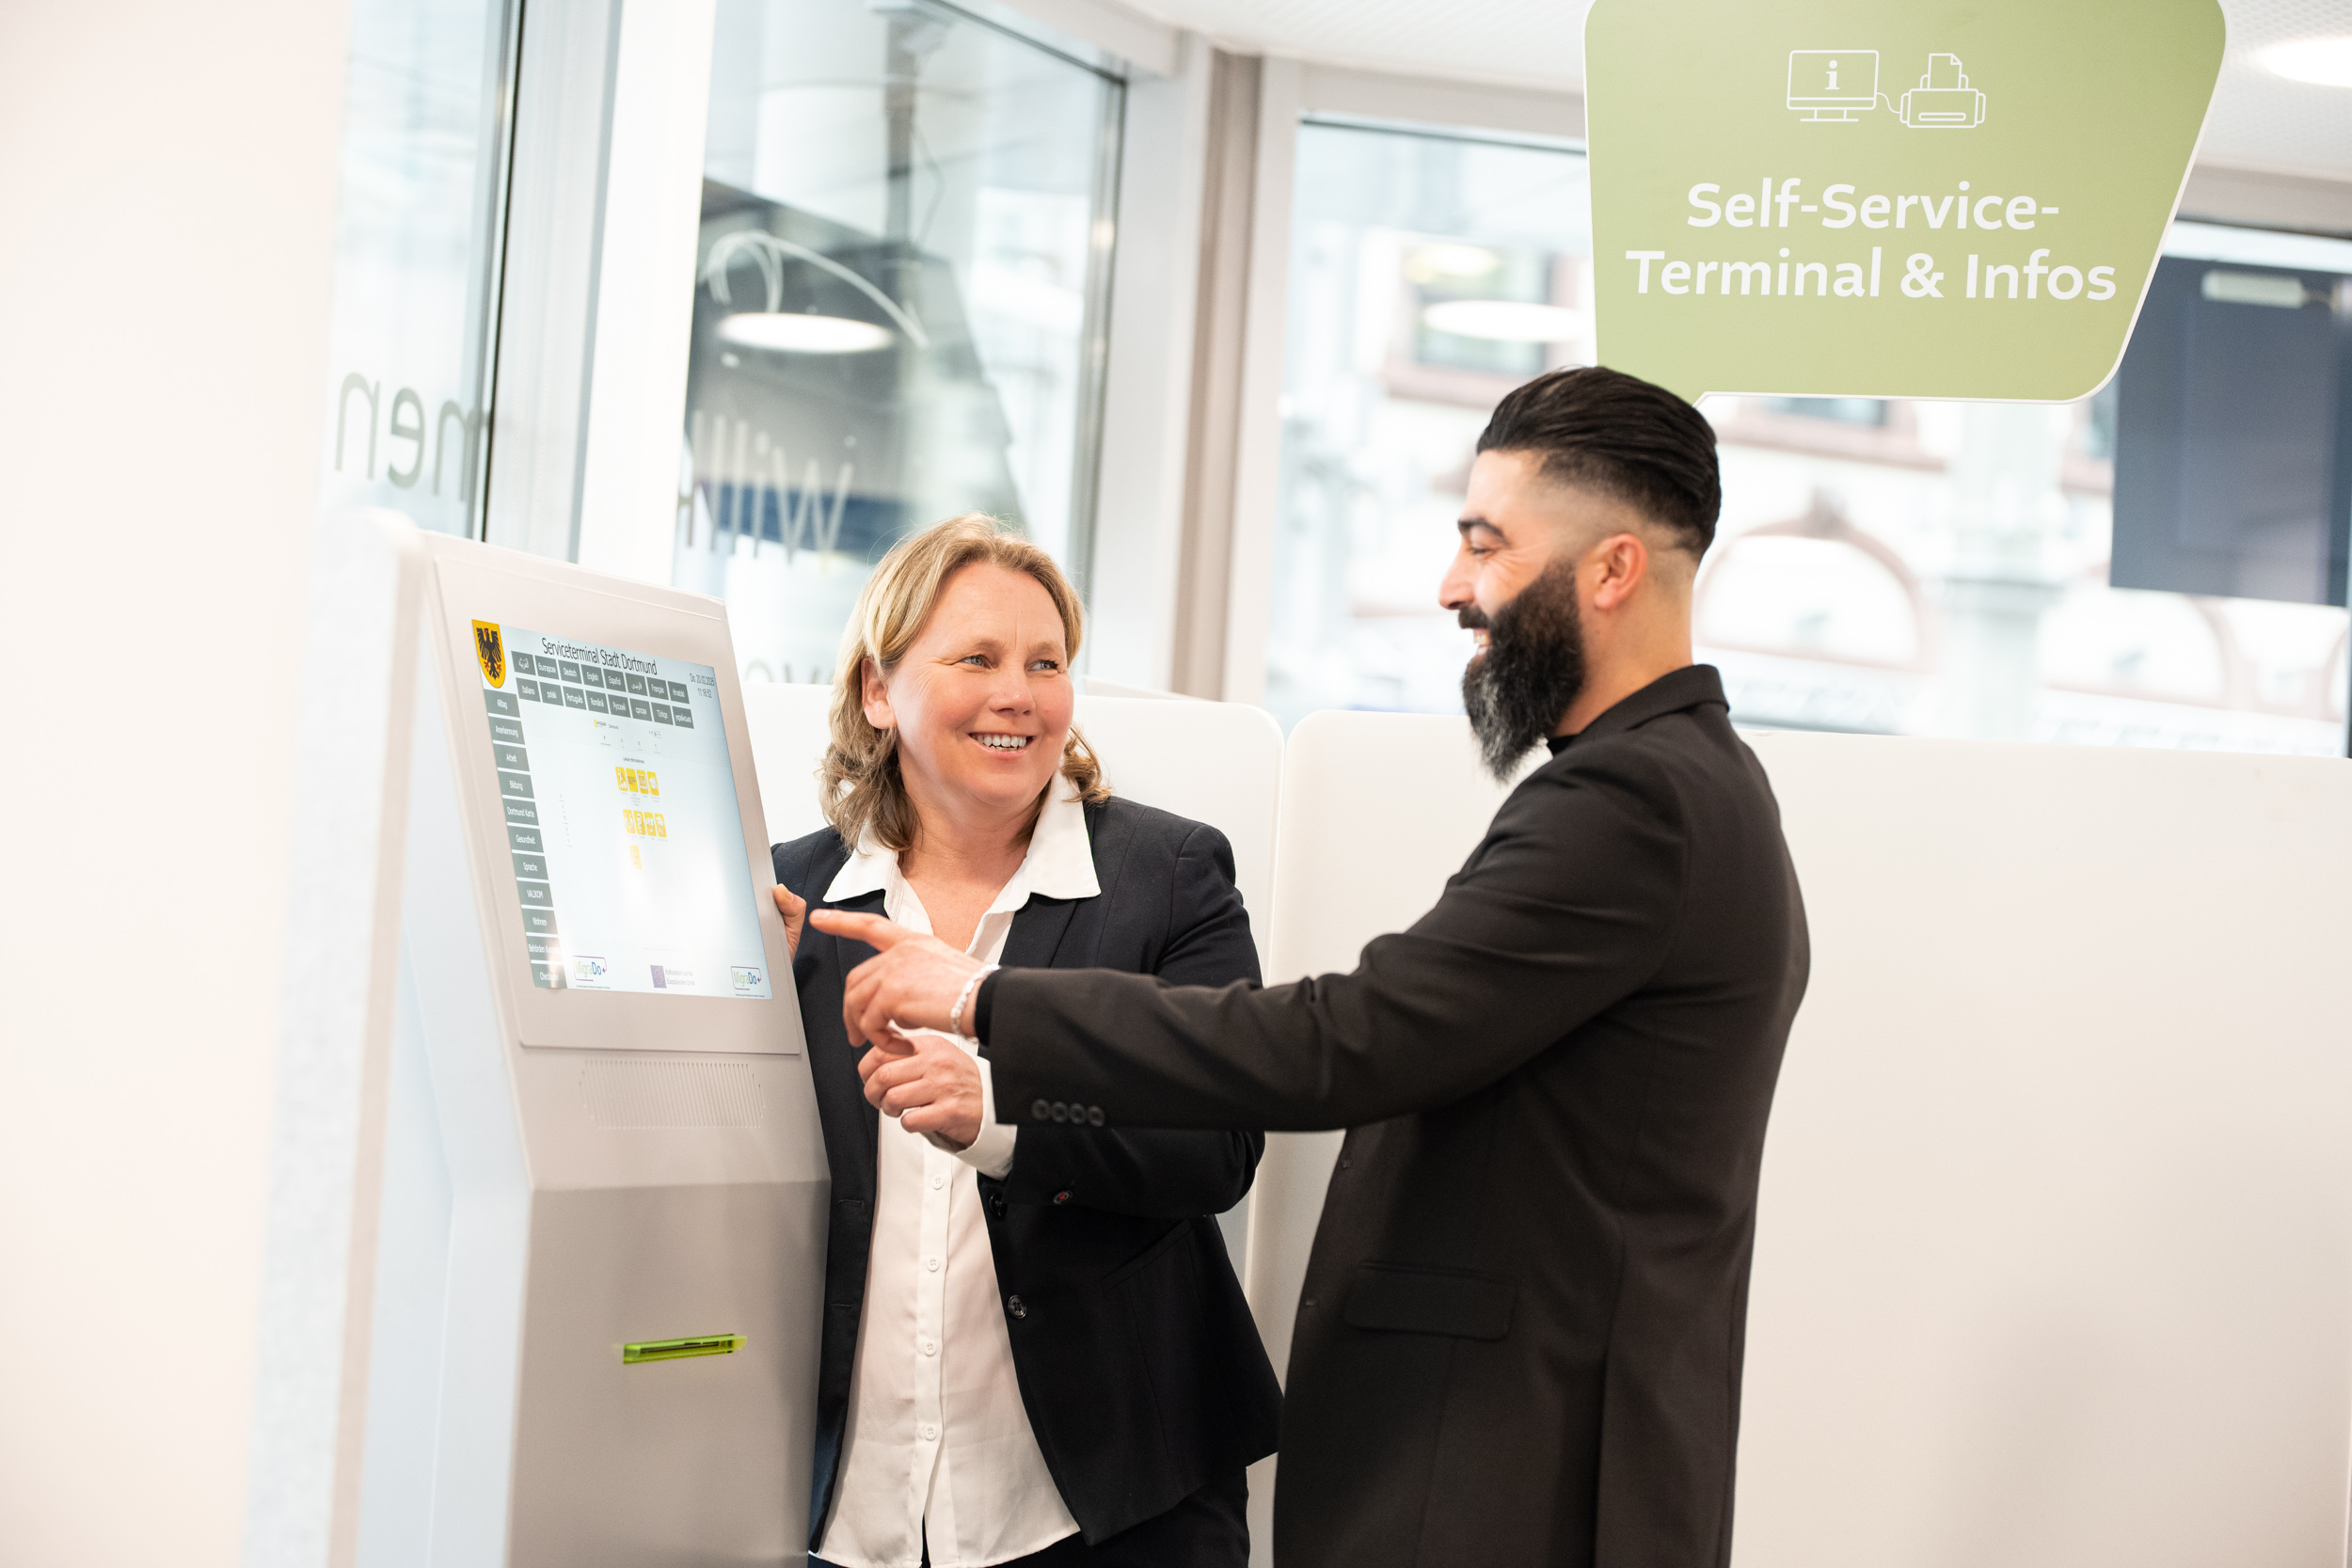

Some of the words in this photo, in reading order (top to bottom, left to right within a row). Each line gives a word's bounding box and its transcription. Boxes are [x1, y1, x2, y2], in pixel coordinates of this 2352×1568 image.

[1687, 177, 2058, 230] Self-Service-
[1626, 246, 1882, 298] Terminal
[1899, 252, 1945, 299] &
[1965, 247, 2117, 302] Infos
[542, 638, 599, 663] Serviceterminal
[600, 649, 621, 669] Stadt
[621, 653, 658, 675] Dortmund
[564, 667, 578, 677] Deutsch
[586, 672, 599, 682] English
[521, 685, 535, 695] Italiano
[651, 684, 665, 694] Français
[497, 699, 508, 710] Alltag
[566, 693, 583, 705] Português
[495, 725, 518, 738] Anerkennung
[506, 753, 517, 763] Arbeit
[509, 780, 523, 792] Bildung
[507, 806, 525, 816] Dortmund
[525, 809, 535, 818] Karte
[516, 834, 536, 845] Gesundheit
[523, 862, 538, 872] Sprache
[532, 917, 548, 927] Wohnen
[575, 961, 602, 978] MigraDo
[733, 971, 757, 987] MigraDo
